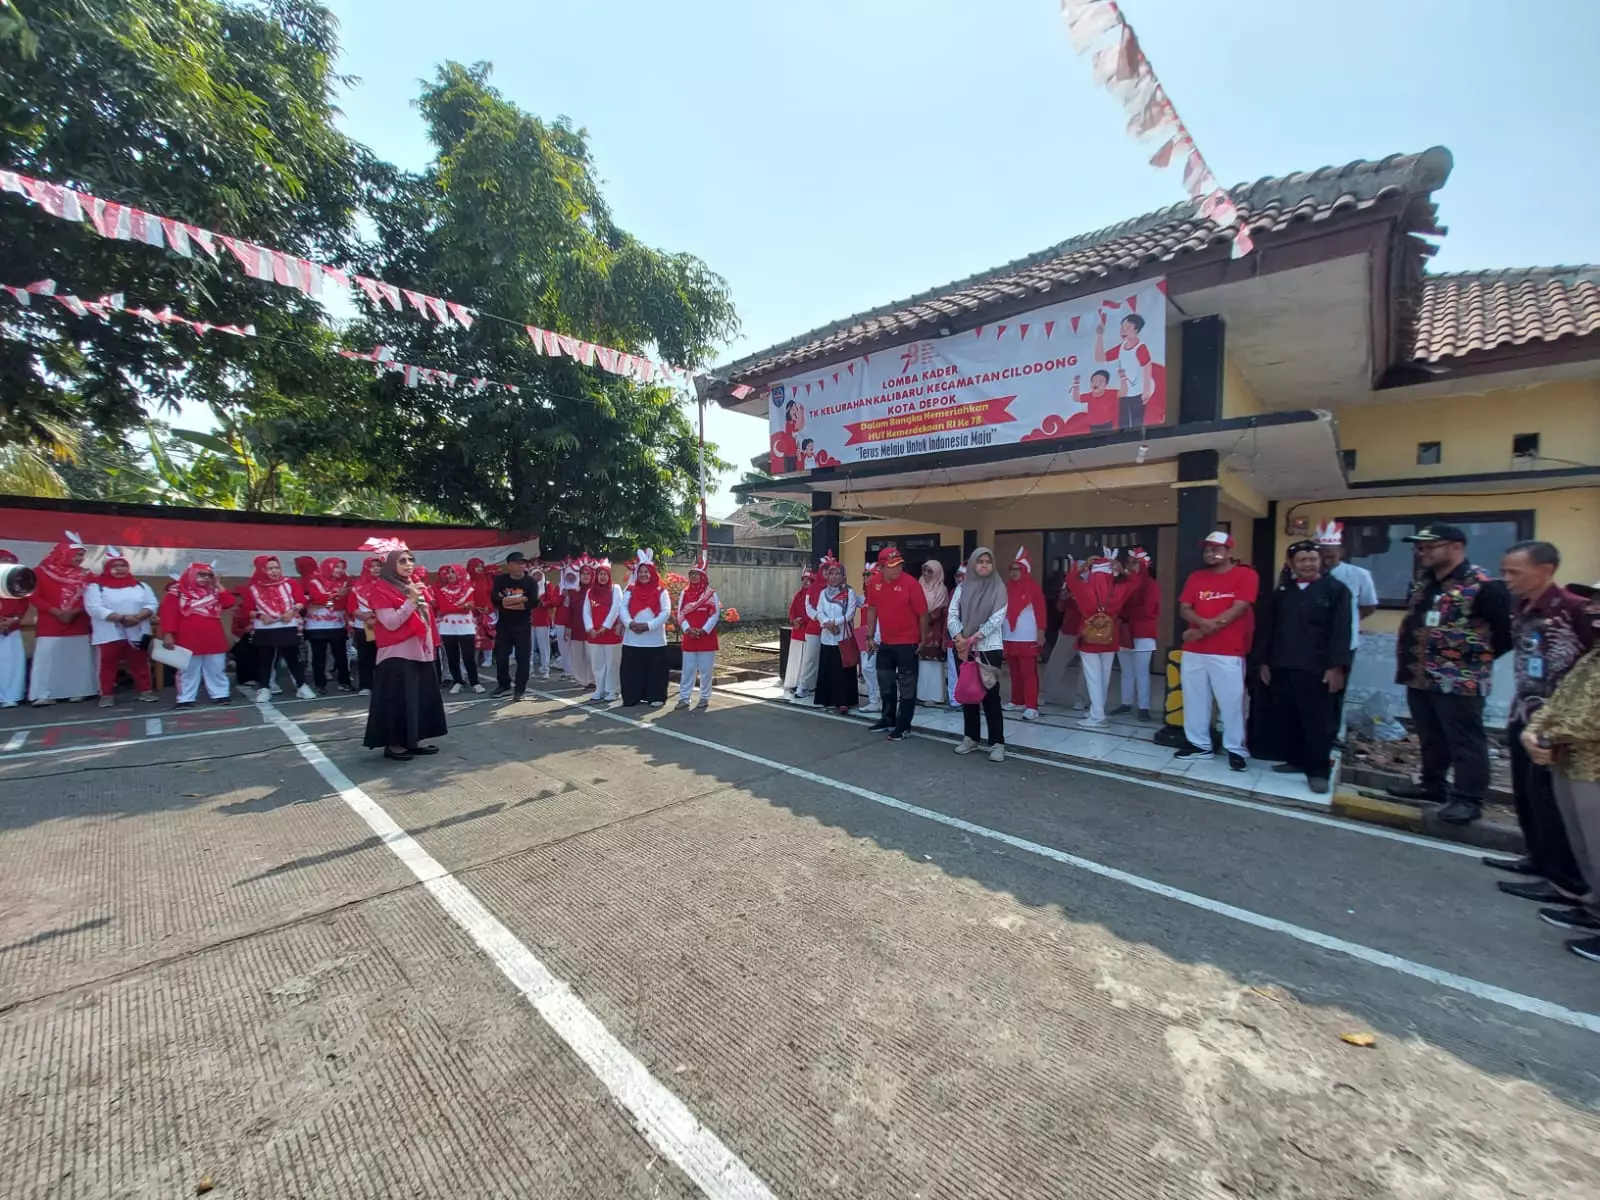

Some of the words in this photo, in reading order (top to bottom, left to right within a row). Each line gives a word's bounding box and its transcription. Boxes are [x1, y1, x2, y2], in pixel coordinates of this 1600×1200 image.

[809, 409, 819, 419] TK
[820, 396, 873, 416] KELURAHAN
[873, 386, 924, 405] KALIBARU
[926, 371, 1000, 394] KECAMATAN
[1001, 355, 1078, 380] CILODONG
[883, 374, 918, 389] LOMBA
[922, 364, 958, 381] KADER
[887, 401, 916, 416] KOTA
[919, 394, 957, 410] DEPOK
[860, 420, 889, 431] Dalam
[889, 415, 923, 426] Rangka
[923, 404, 989, 422] Memeriahkan
[867, 431, 886, 441] HUT
[886, 423, 945, 438] Kemerdekaan
[946, 418, 957, 429] RI
[957, 418, 970, 428] Ke
[880, 442, 905, 458] Melaju
[906, 438, 927, 453] Untuk
[928, 434, 969, 451] Indonesia
